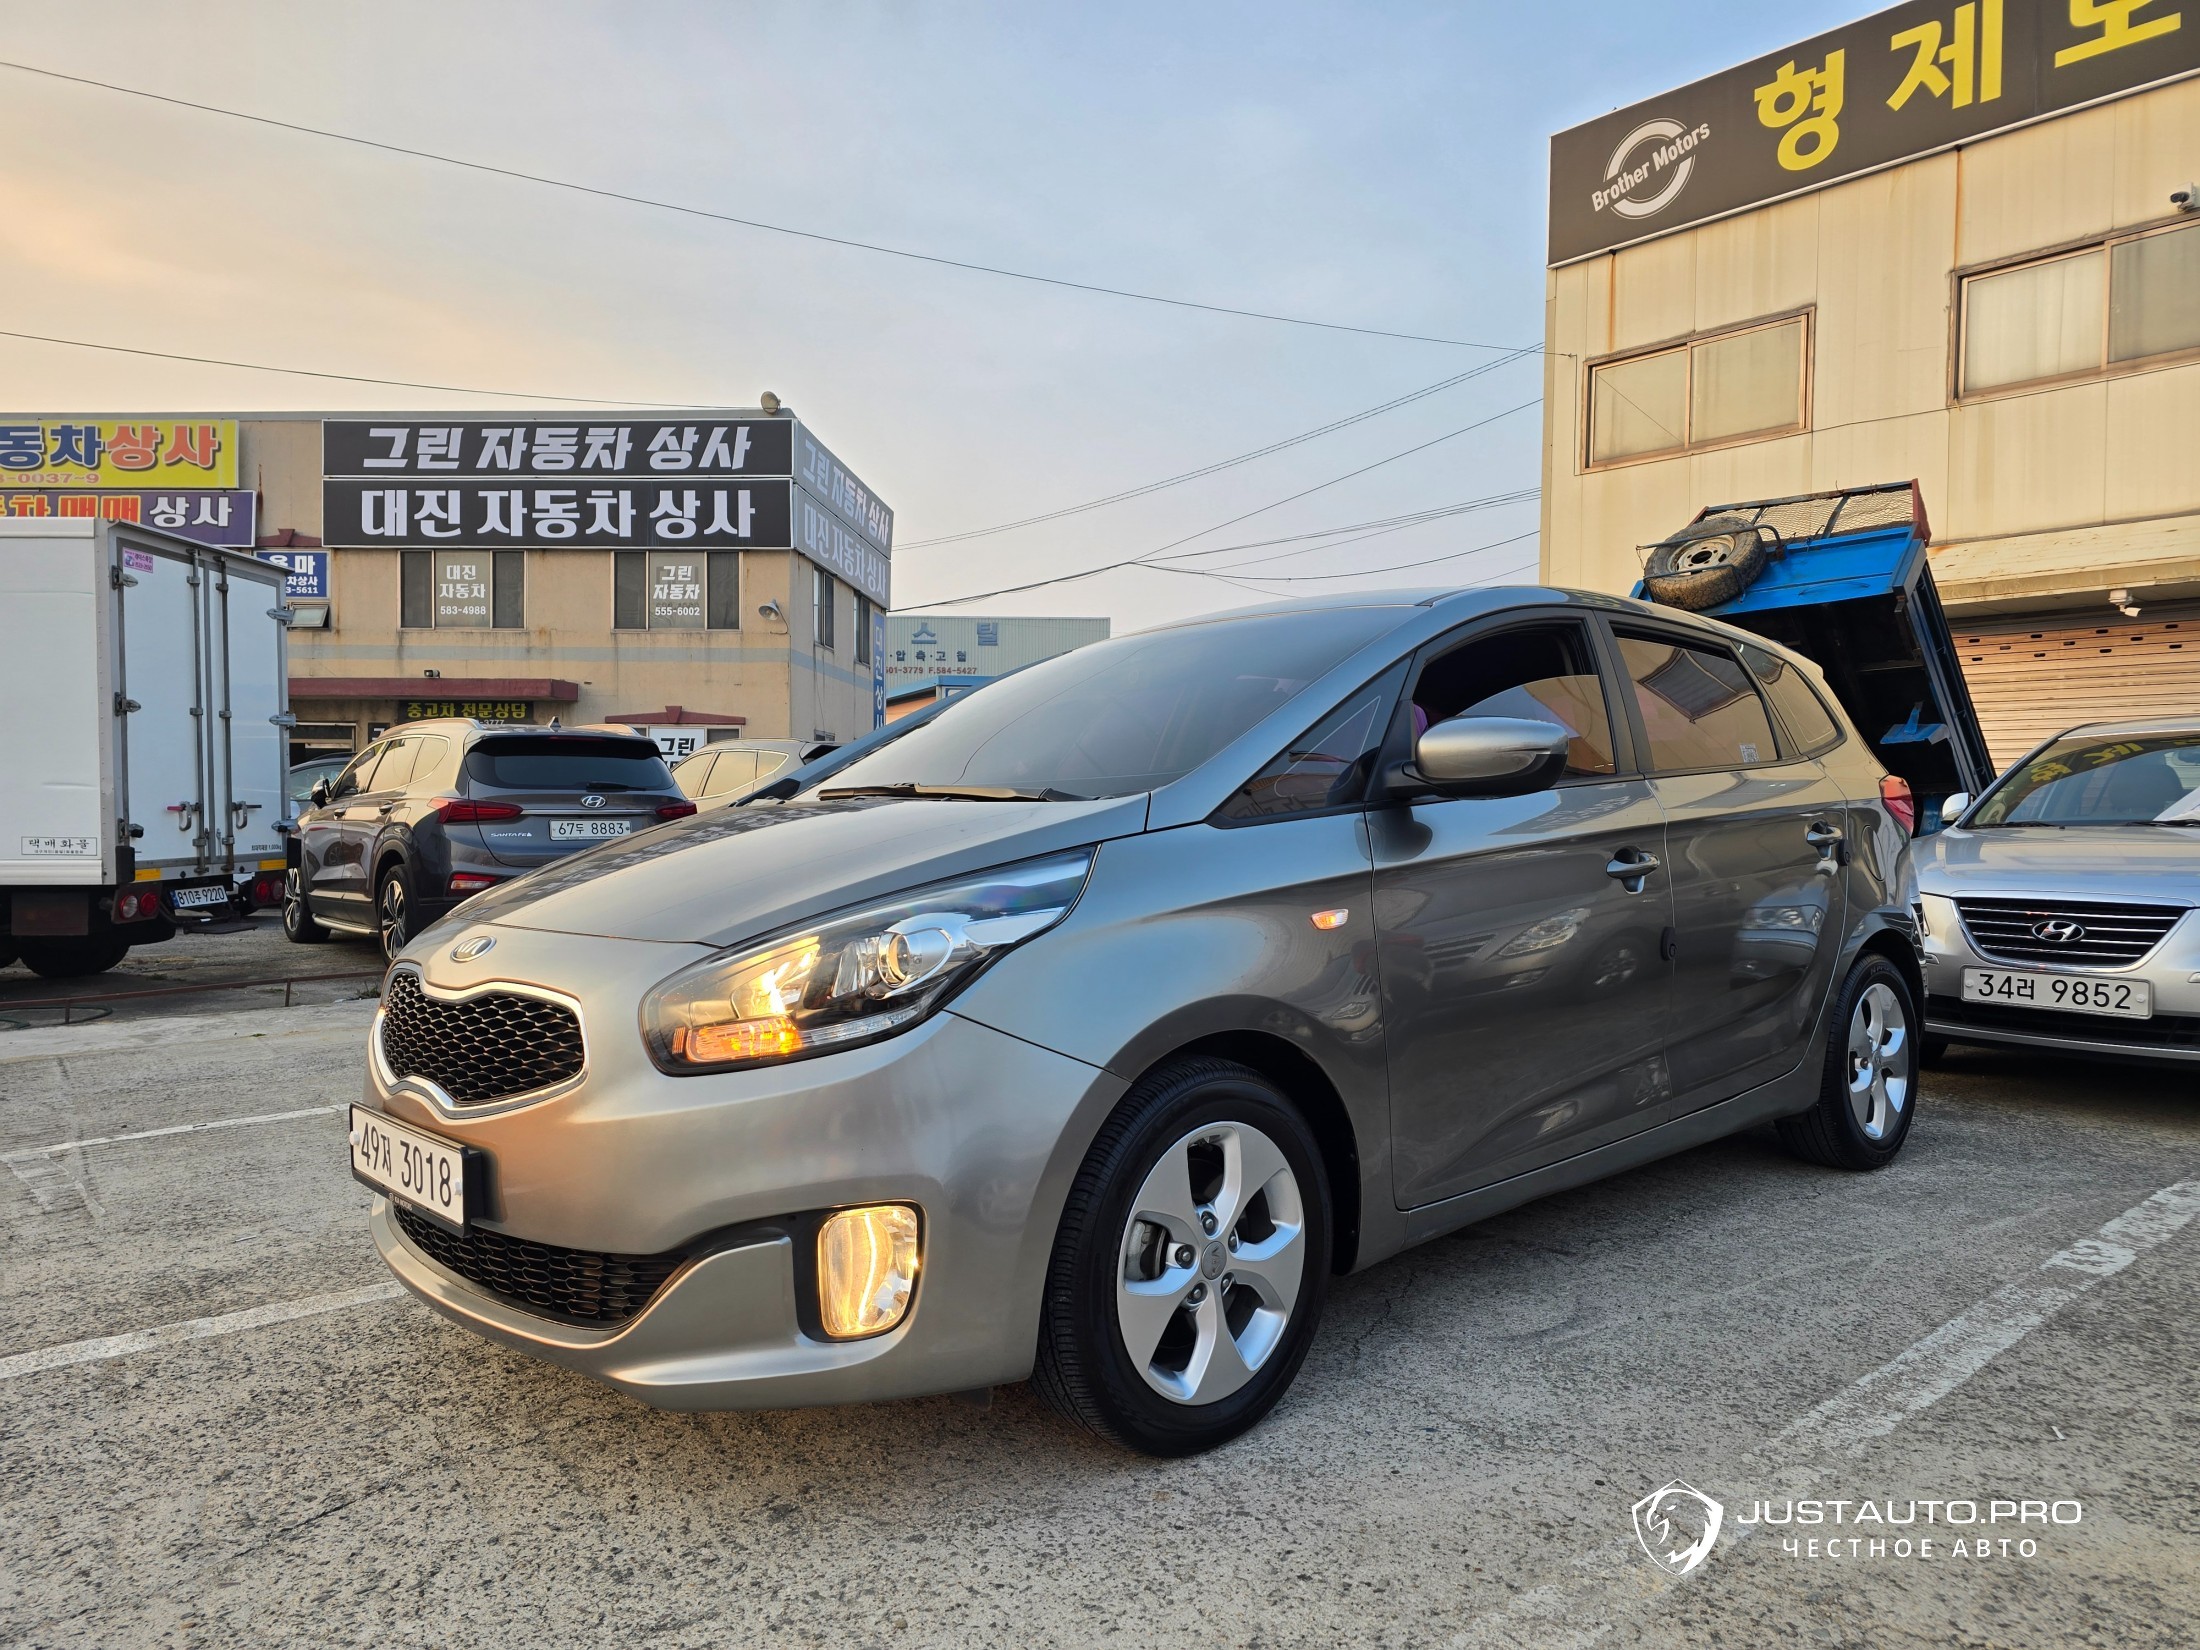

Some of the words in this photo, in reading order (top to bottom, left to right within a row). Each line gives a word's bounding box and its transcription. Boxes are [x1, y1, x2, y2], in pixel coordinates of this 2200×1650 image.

[1591, 161, 1650, 212] Brother
[1652, 123, 1710, 172] Motors
[363, 427, 464, 470] 그린
[475, 427, 633, 471] 자동차
[646, 426, 752, 470] 상사
[803, 438, 830, 496] 그린
[831, 464, 867, 527] 자동차
[868, 500, 890, 546] 상사
[0, 495, 51, 517] 차
[150, 496, 233, 528] 상사
[361, 489, 461, 538] 대진
[477, 489, 637, 538] 자동차
[649, 489, 756, 539] 상사
[804, 502, 829, 559] 대진
[832, 525, 865, 584] 자동차
[867, 553, 886, 599] 상사
[446, 565, 477, 580] 대진
[661, 565, 693, 581] 그린
[439, 583, 486, 599] 자동차
[653, 583, 700, 600] 자동차
[440, 605, 486, 615] 583-4988
[654, 606, 701, 616] 555-6002
[407, 702, 455, 718] 중고차
[461, 702, 527, 719] 전문상담
[660, 737, 696, 757] 그린
[558, 822, 585, 835] 67두
[591, 822, 624, 835] 8883
[201, 887, 225, 902] 9220
[1978, 973, 2035, 1000] 34러
[2051, 979, 2132, 1010] 9852
[361, 1122, 392, 1178] 49저
[400, 1140, 452, 1208] 3018
